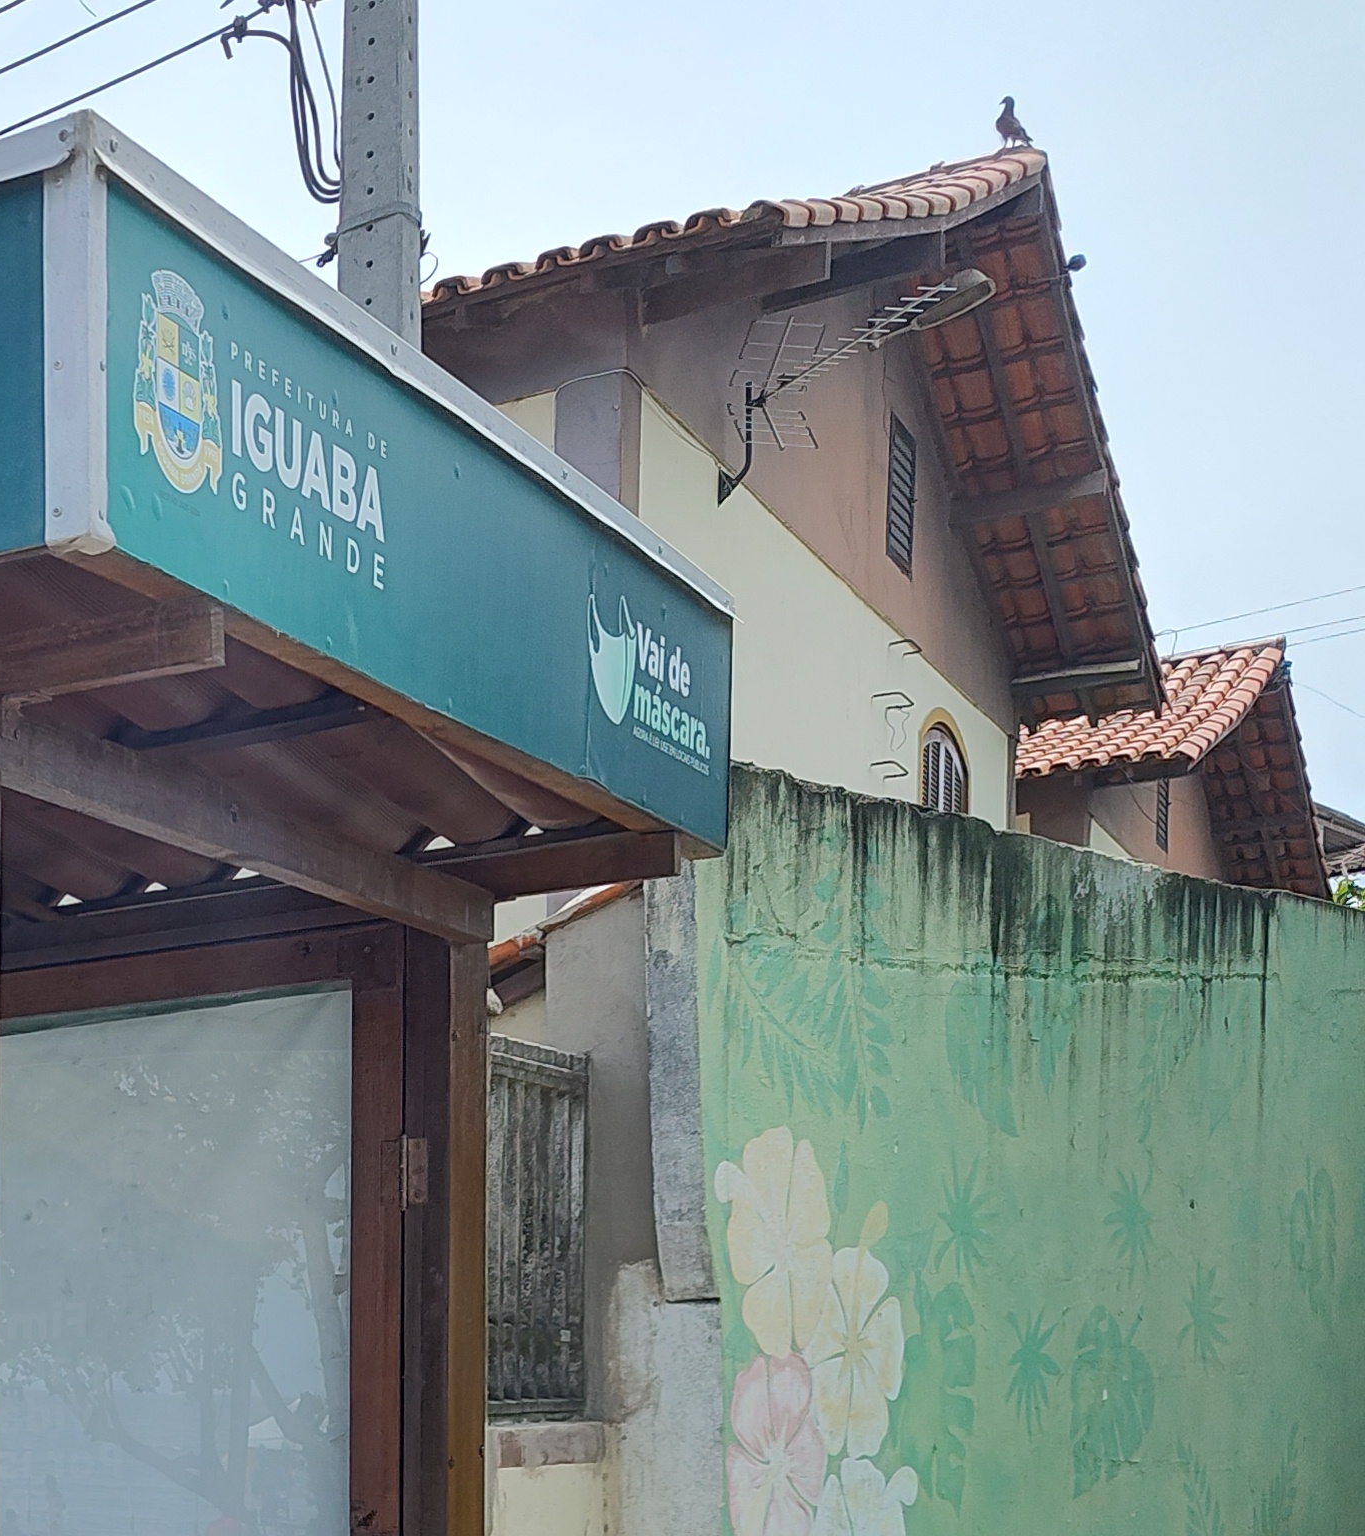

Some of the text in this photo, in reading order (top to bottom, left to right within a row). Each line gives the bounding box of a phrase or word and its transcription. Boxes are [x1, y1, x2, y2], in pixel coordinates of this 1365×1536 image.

[231, 342, 387, 459] PREFEITURA DE
[231, 379, 385, 543] IGUABA
[232, 473, 385, 590] GRANDE
[636, 621, 691, 697] Vai de
[633, 682, 711, 759] máscara.
